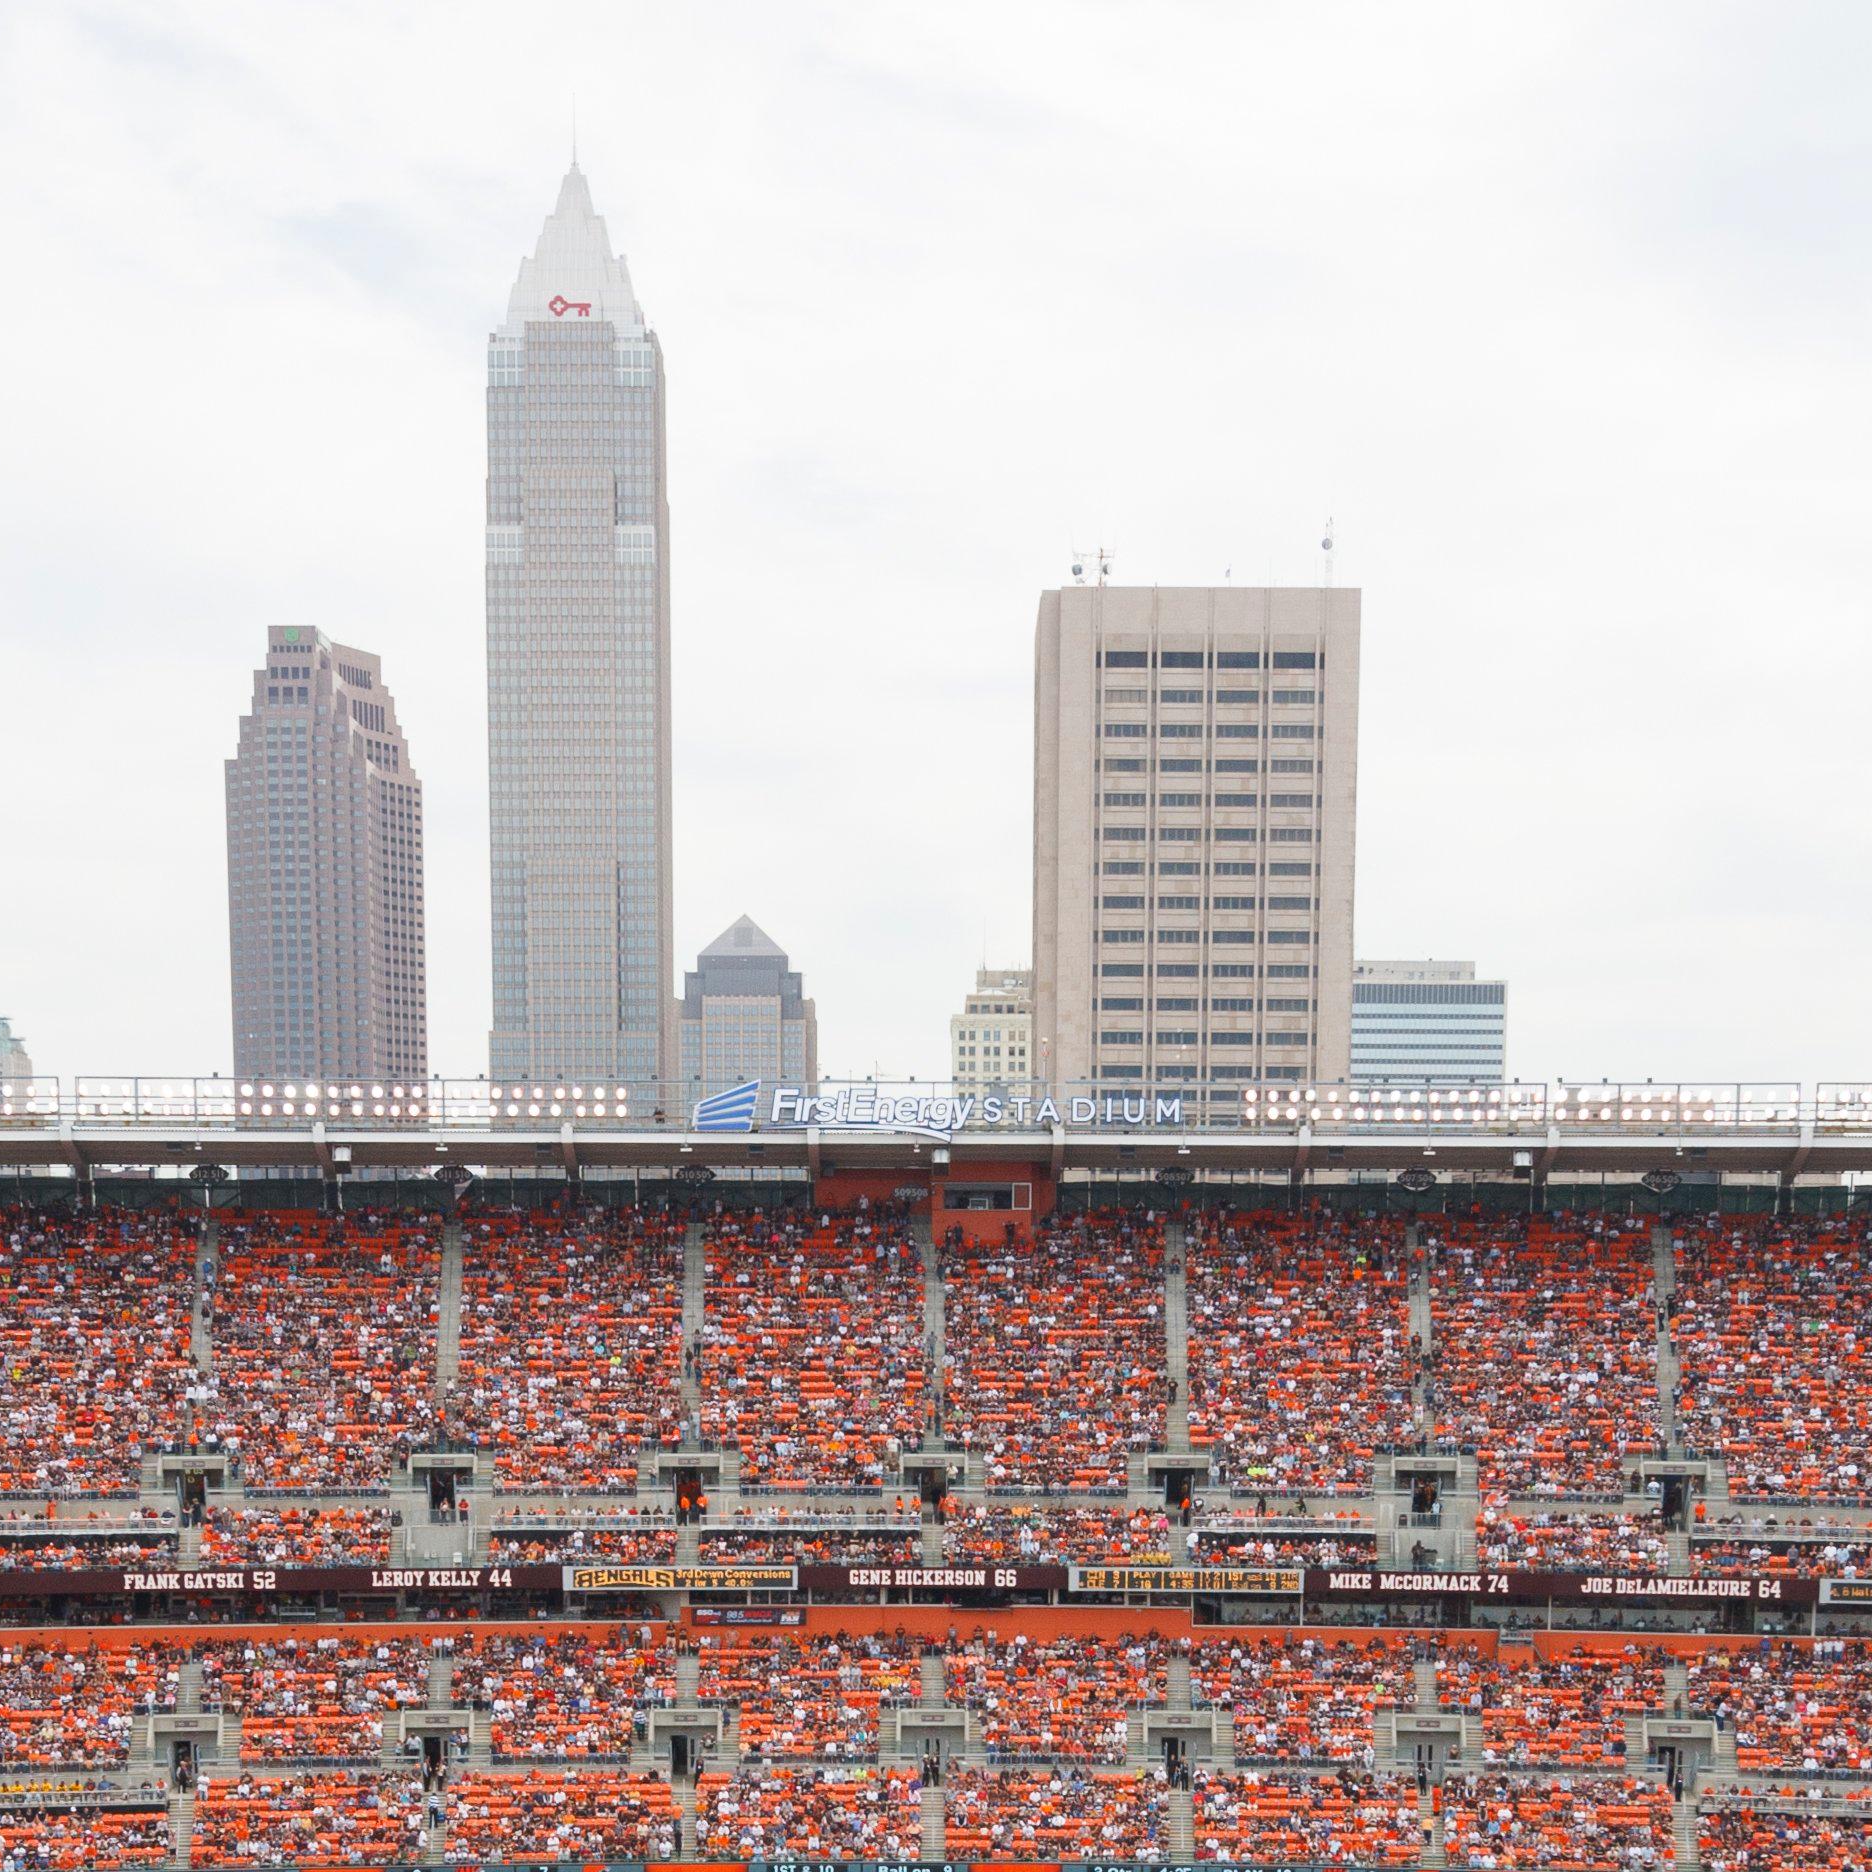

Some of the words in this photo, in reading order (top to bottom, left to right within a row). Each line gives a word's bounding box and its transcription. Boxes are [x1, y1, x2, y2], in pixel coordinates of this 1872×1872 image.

[770, 1087, 975, 1131] FirstEnergy
[982, 1097, 1182, 1123] STADIUM
[123, 1573, 181, 1590] FRANK
[183, 1573, 245, 1589] GATSKI
[252, 1572, 276, 1589] 52
[372, 1571, 424, 1587] LEROY
[428, 1571, 480, 1587] KELLY
[489, 1570, 512, 1586] 44
[677, 1570, 695, 1579] 3rd
[696, 1570, 724, 1579] Down
[725, 1570, 792, 1579] Conversions
[849, 1569, 890, 1586] GENE
[895, 1569, 986, 1586] HICKERSON
[994, 1568, 1017, 1587] 66
[1133, 1571, 1158, 1580] PLAY
[1329, 1574, 1372, 1589] MIKE
[1379, 1574, 1482, 1591] McCORMACK
[1487, 1575, 1509, 1593] 74
[1581, 1578, 1613, 1594] JOE
[1615, 1578, 1751, 1597] DeLAMIELLEURE
[1758, 1580, 1782, 1598] 64
